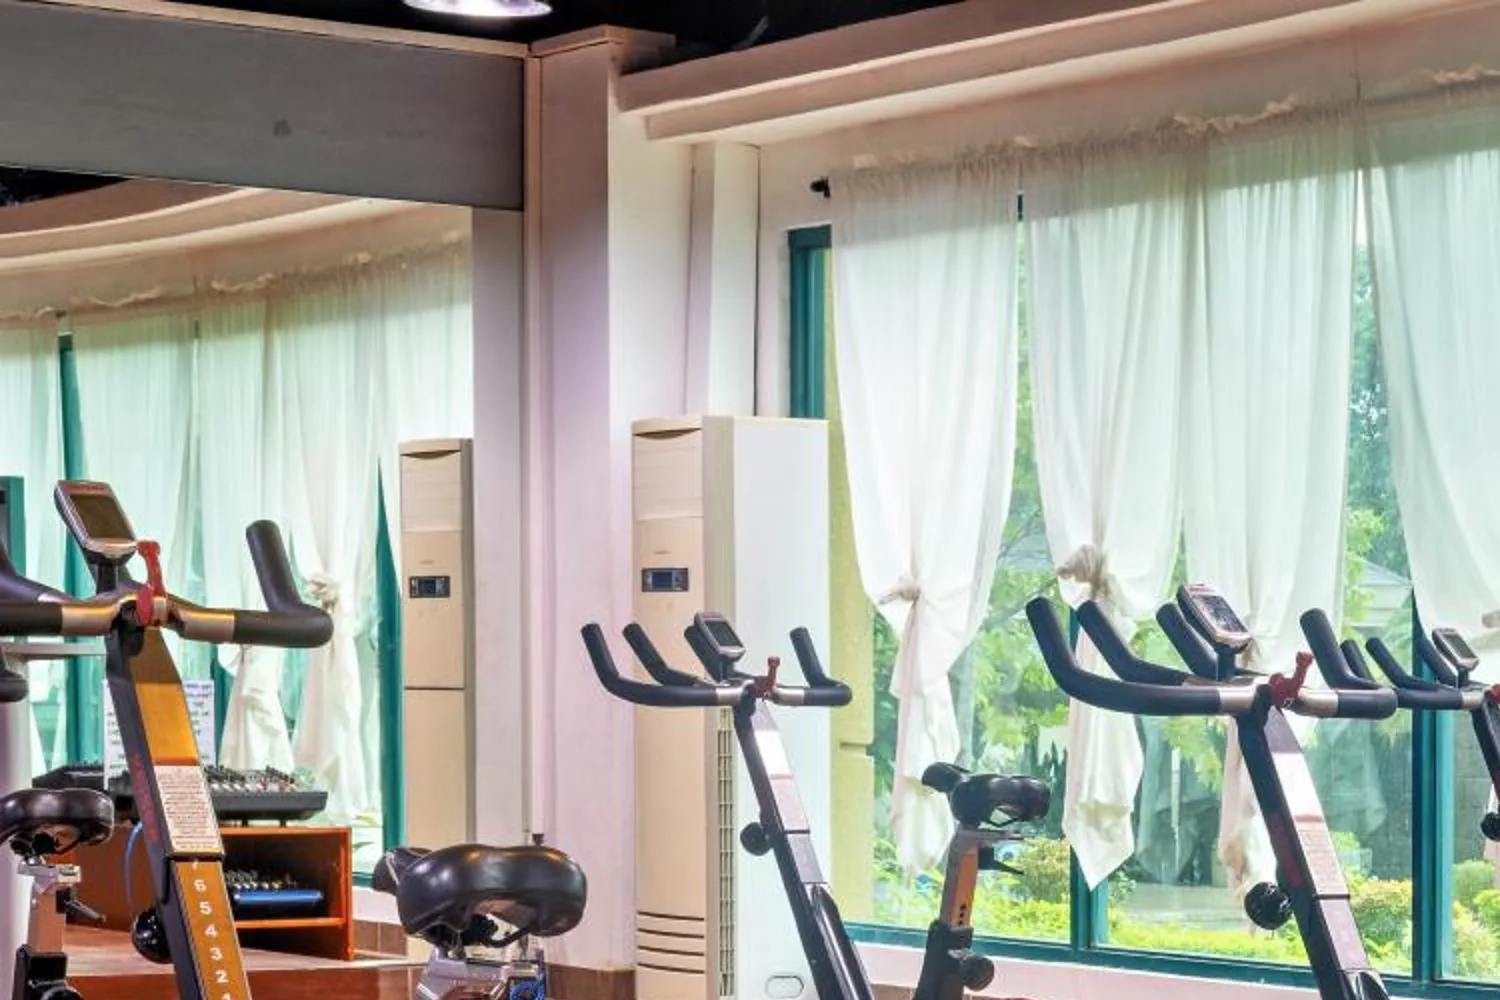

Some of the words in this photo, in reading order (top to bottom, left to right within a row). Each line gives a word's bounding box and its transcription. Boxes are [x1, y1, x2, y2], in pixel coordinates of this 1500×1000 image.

[193, 879, 207, 893] 6
[199, 901, 212, 915] 5
[204, 924, 217, 938] 4
[209, 947, 223, 960] 3
[215, 969, 229, 983] 2
